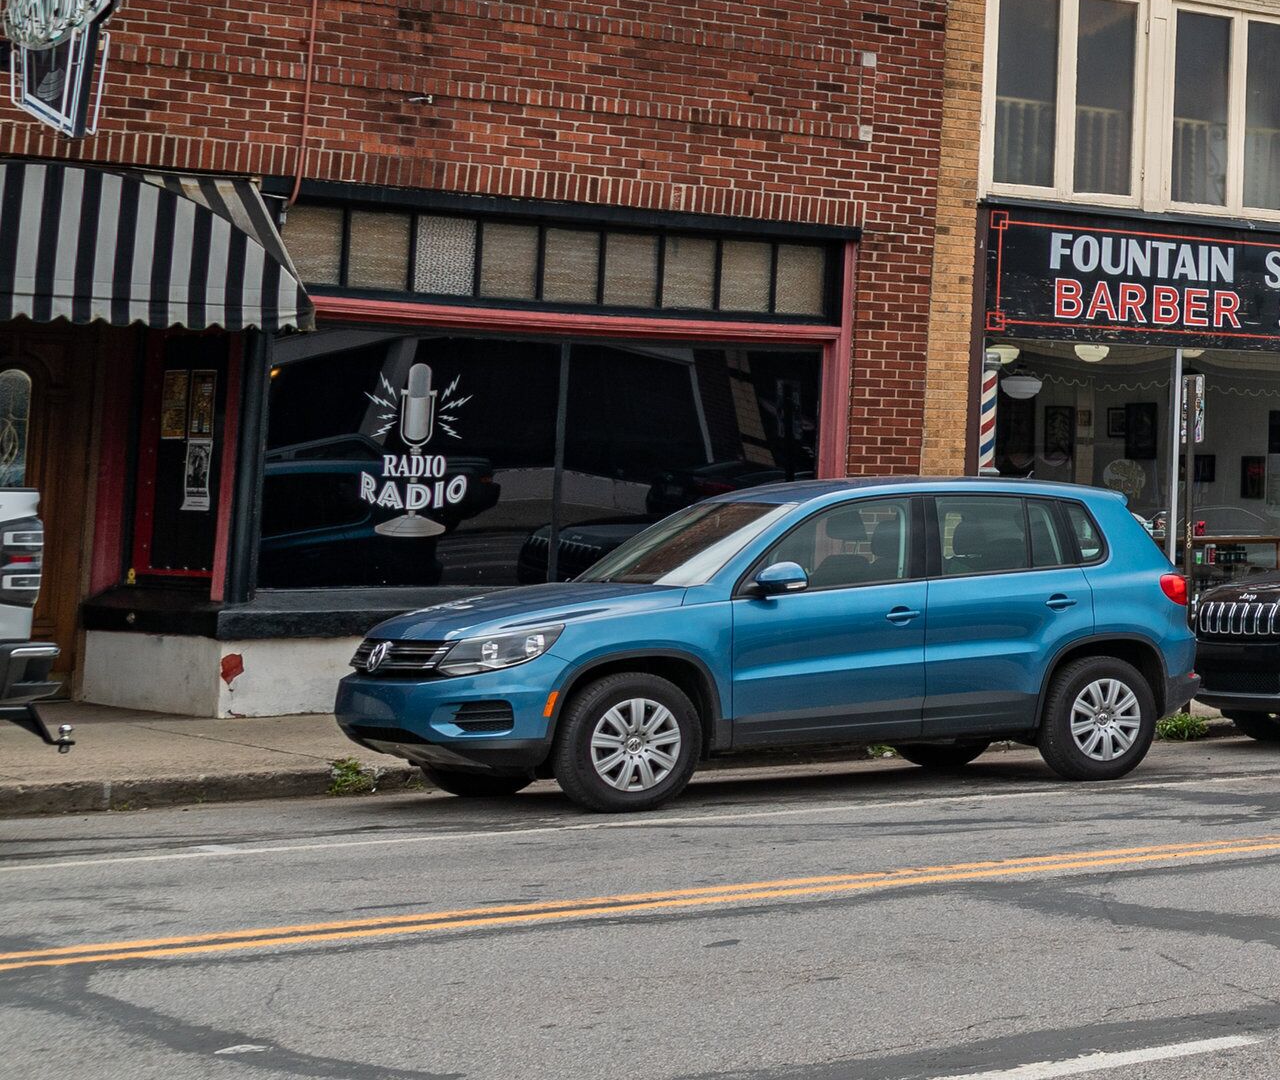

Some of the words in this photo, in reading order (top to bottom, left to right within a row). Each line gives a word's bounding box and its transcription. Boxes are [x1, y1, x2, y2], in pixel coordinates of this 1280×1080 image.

[1050, 232, 1234, 284] FOUNTAIN
[1054, 277, 1241, 329] BARBER
[381, 454, 447, 477] RADIO
[360, 471, 467, 510] RADIO
[1239, 592, 1257, 602] Jeep
